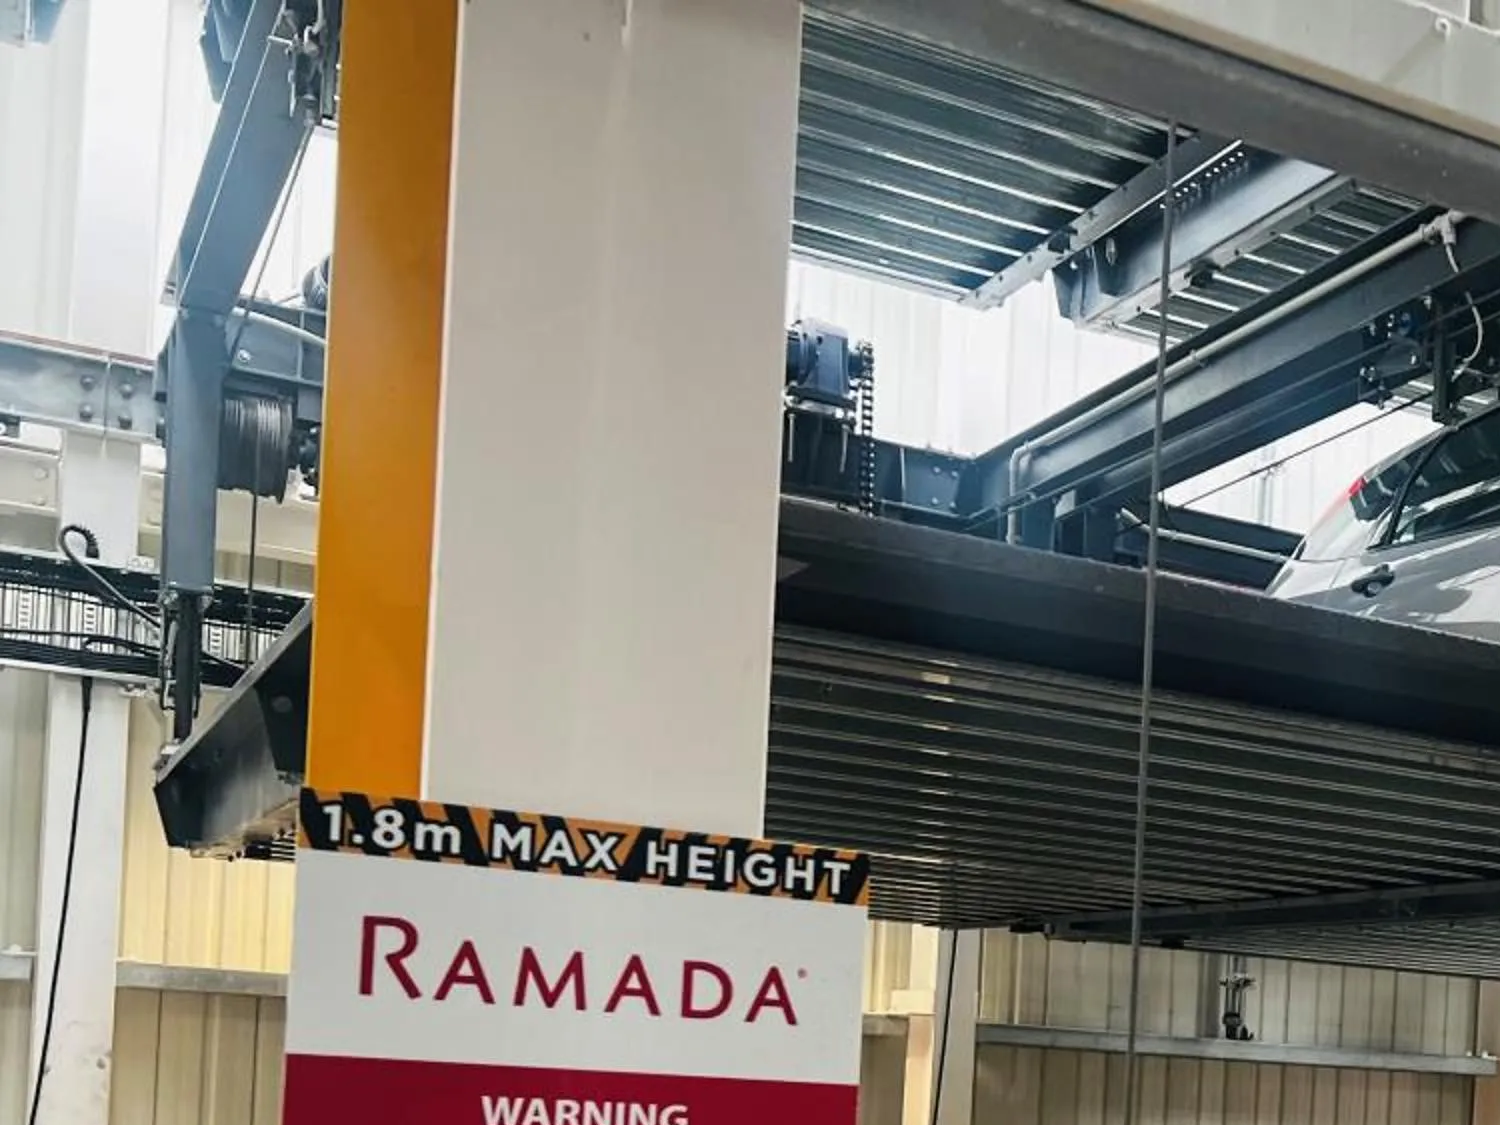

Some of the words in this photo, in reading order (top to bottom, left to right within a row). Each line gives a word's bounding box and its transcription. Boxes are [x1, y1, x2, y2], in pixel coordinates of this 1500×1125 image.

[324, 806, 460, 853] 1.8m
[493, 824, 617, 870] MAX
[647, 842, 850, 893] HEIGHT
[360, 916, 796, 1025] RAMADA
